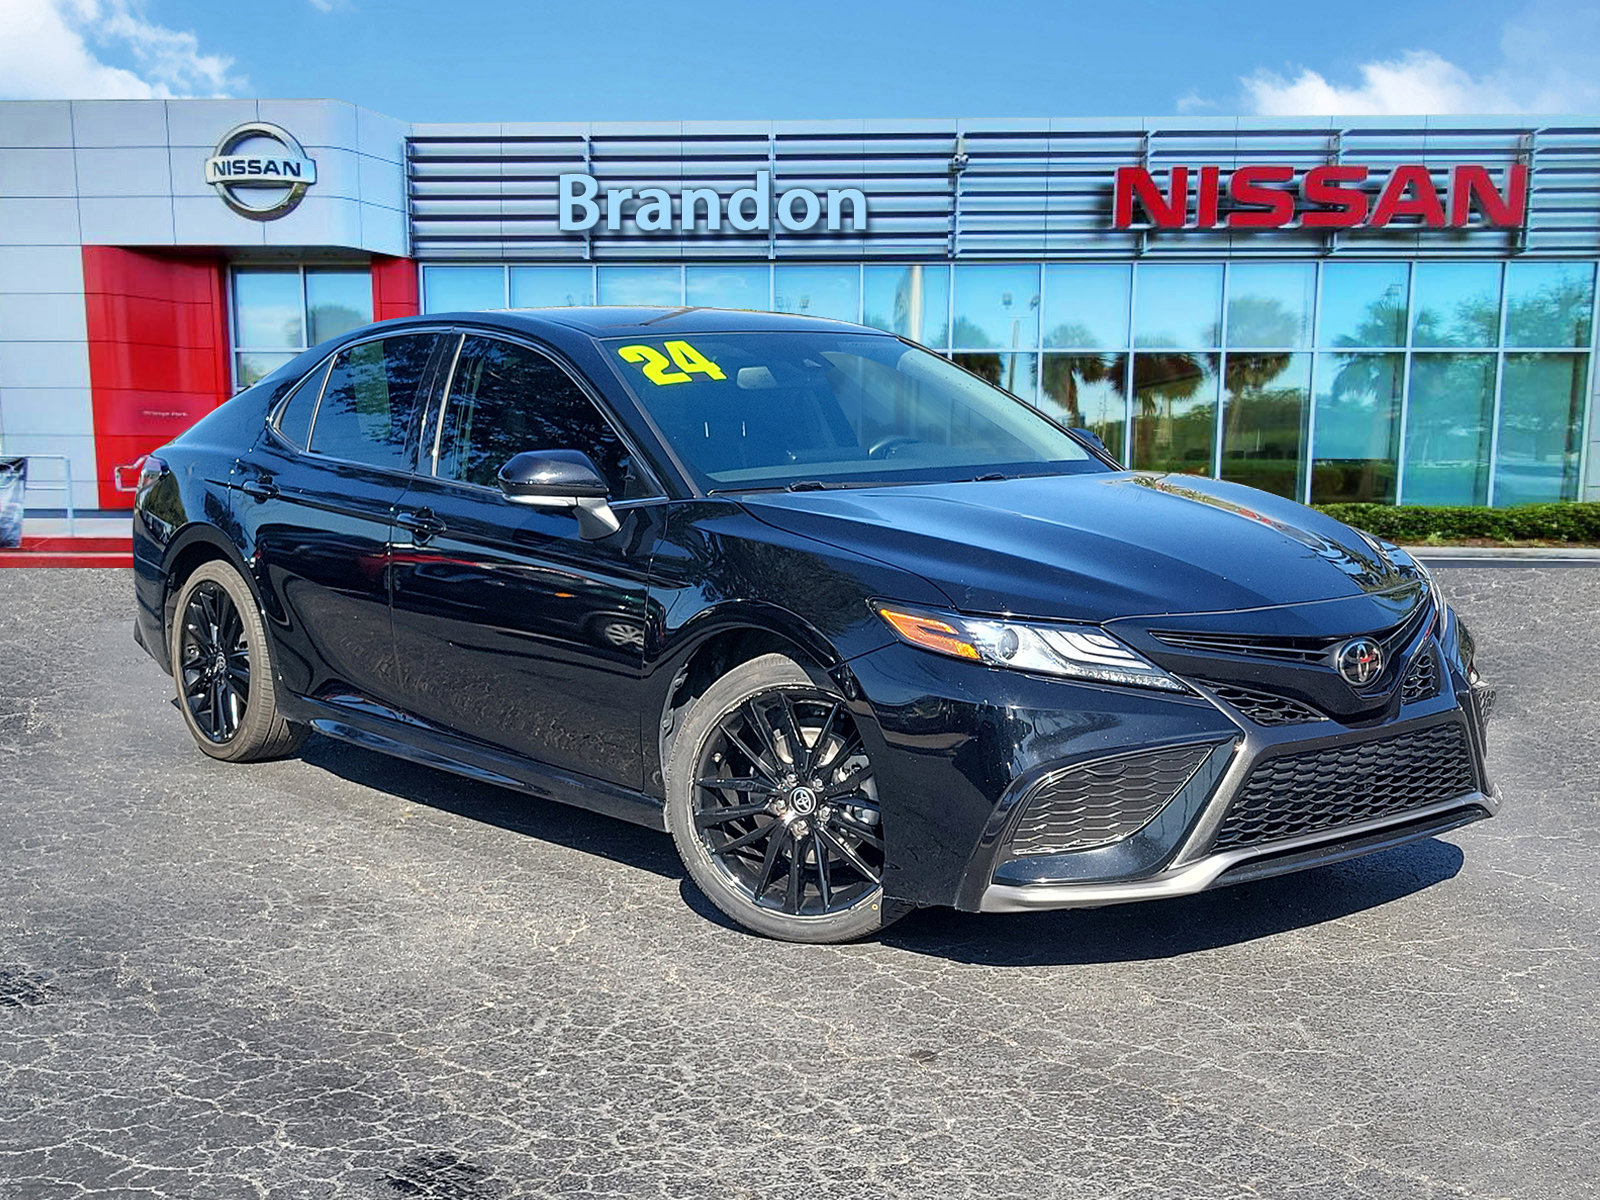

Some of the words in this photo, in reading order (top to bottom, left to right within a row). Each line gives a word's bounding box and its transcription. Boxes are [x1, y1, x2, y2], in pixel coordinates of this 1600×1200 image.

[213, 160, 301, 177] NISSAN
[558, 170, 868, 232] Brandon
[1112, 165, 1528, 230] NISSAN
[617, 340, 727, 386] 24
